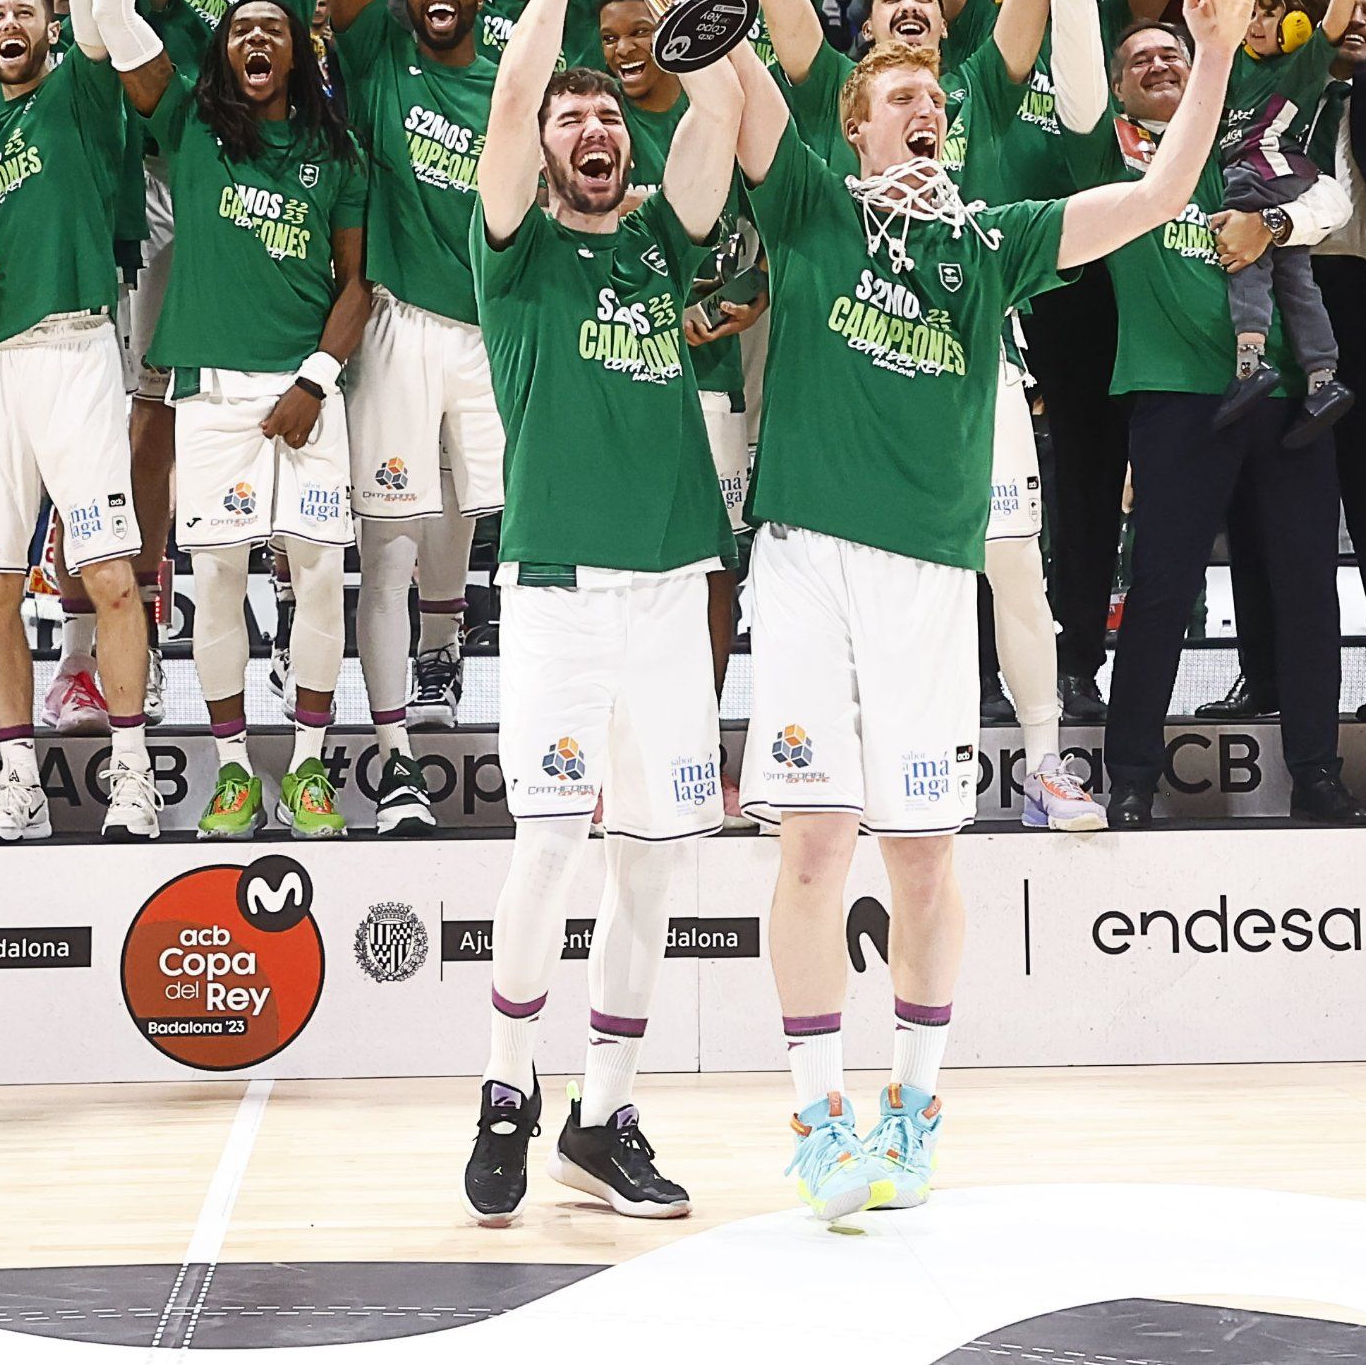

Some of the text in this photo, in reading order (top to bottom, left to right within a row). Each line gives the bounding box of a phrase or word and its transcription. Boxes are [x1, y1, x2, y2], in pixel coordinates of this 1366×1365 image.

[404, 105, 473, 154] S2MOS
[405, 130, 478, 192] MPEON
[234, 183, 284, 219] MOS
[218, 185, 311, 261] CAONES
[648, 292, 674, 314] 22
[855, 269, 929, 327] S2MO
[653, 308, 676, 329] 23
[578, 318, 681, 376] CAMON
[828, 295, 966, 377] CAMPEONES
[847, 333, 888, 358] COPA
[915, 356, 947, 377] REY
[300, 497, 340, 522] laga
[308, 486, 340, 505] má
[726, 492, 743, 510] ga
[993, 498, 1019, 515] aga
[70, 498, 100, 524] má
[680, 753, 716, 783] má
[912, 751, 949, 778] má
[673, 780, 716, 806] laga
[904, 774, 949, 802] laga
[180, 925, 231, 947] acb
[666, 926, 739, 949] dalona
[1093, 894, 1362, 955] endesa
[158, 948, 256, 981] Copa
[165, 982, 271, 1016] del Rey
[148, 1020, 245, 1035] Badalona '23
